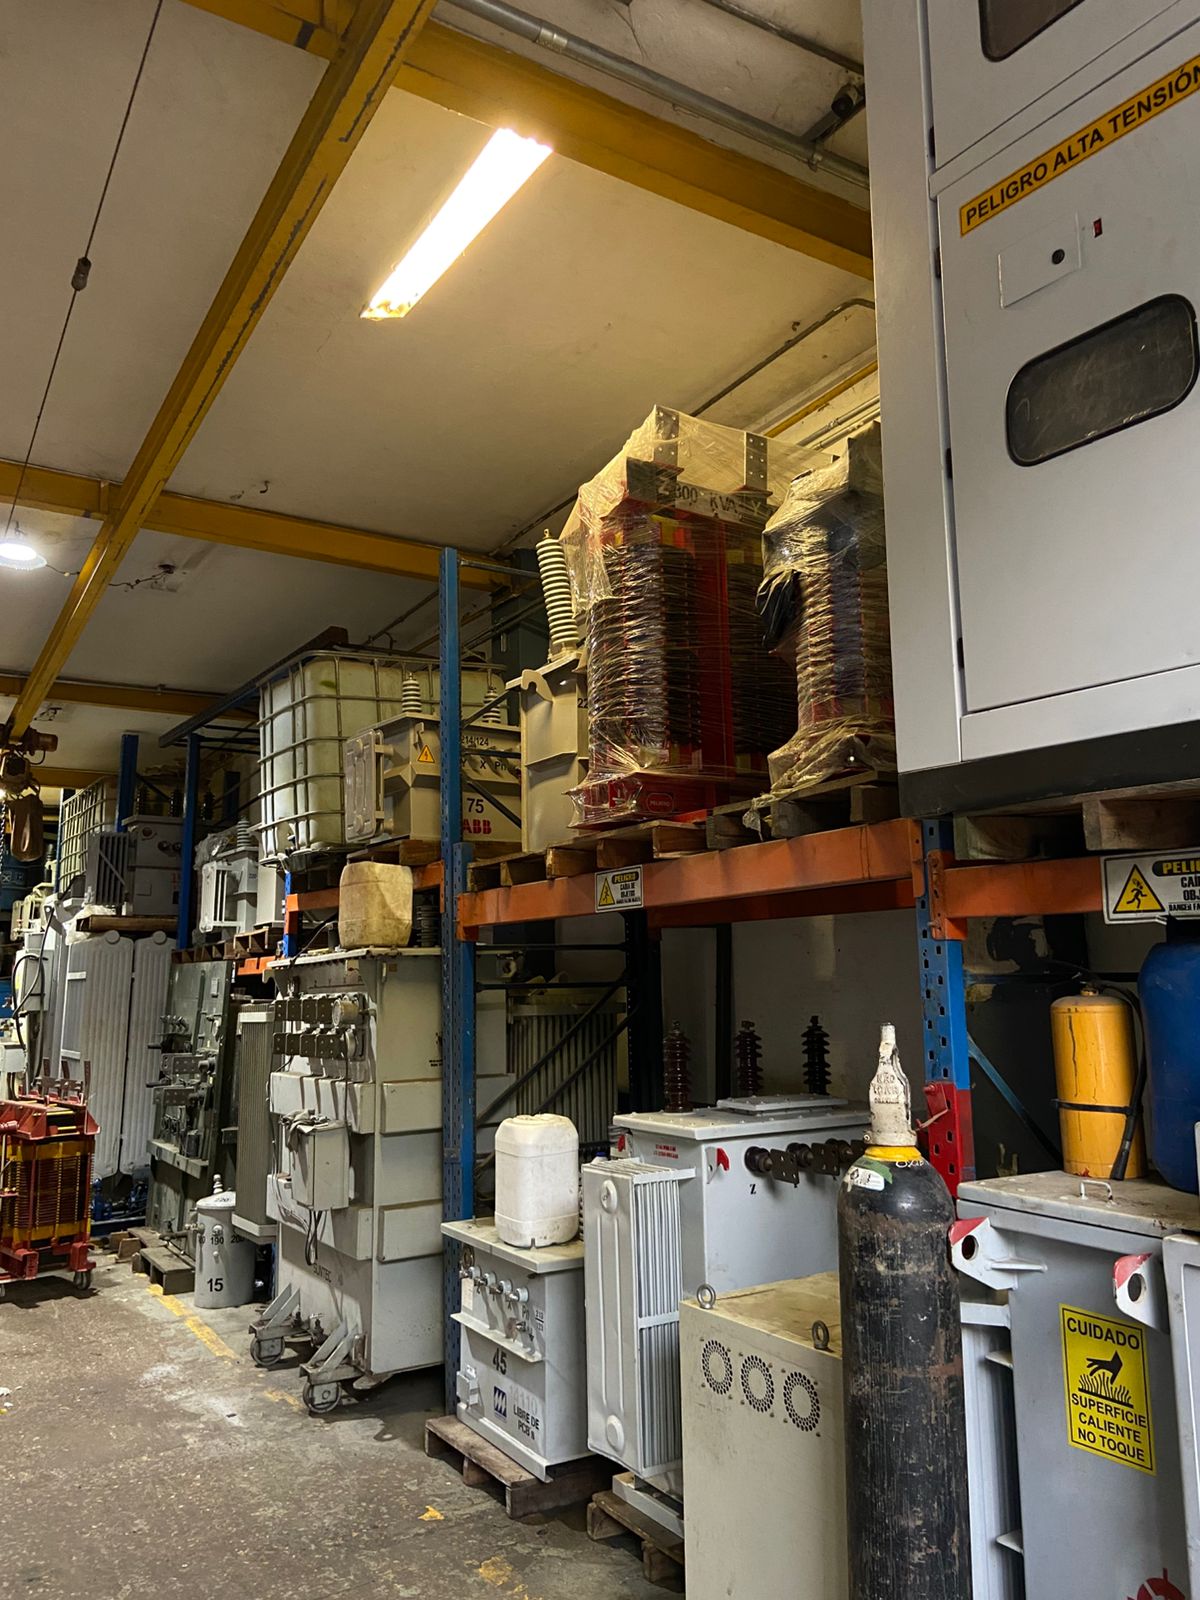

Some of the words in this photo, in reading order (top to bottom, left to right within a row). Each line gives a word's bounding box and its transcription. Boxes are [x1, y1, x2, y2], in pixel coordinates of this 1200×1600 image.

[966, 163, 1048, 226] PELIGRO
[1053, 127, 1105, 172] ALTA
[479, 760, 487, 770] X
[466, 797, 485, 814] 75
[462, 818, 492, 835] ABB
[210, 1235, 225, 1246] 190
[207, 1277, 224, 1293] 15
[1067, 1317, 1140, 1350] CUIDADO
[492, 1346, 507, 1376] 45
[512, 1403, 531, 1418] LIBRE
[530, 1412, 540, 1431] DE
[1071, 1393, 1147, 1429] SUPERFICIE
[1078, 1412, 1142, 1444] CALIENTE
[1077, 1427, 1097, 1445] NO
[1099, 1434, 1146, 1463] TOQUE
